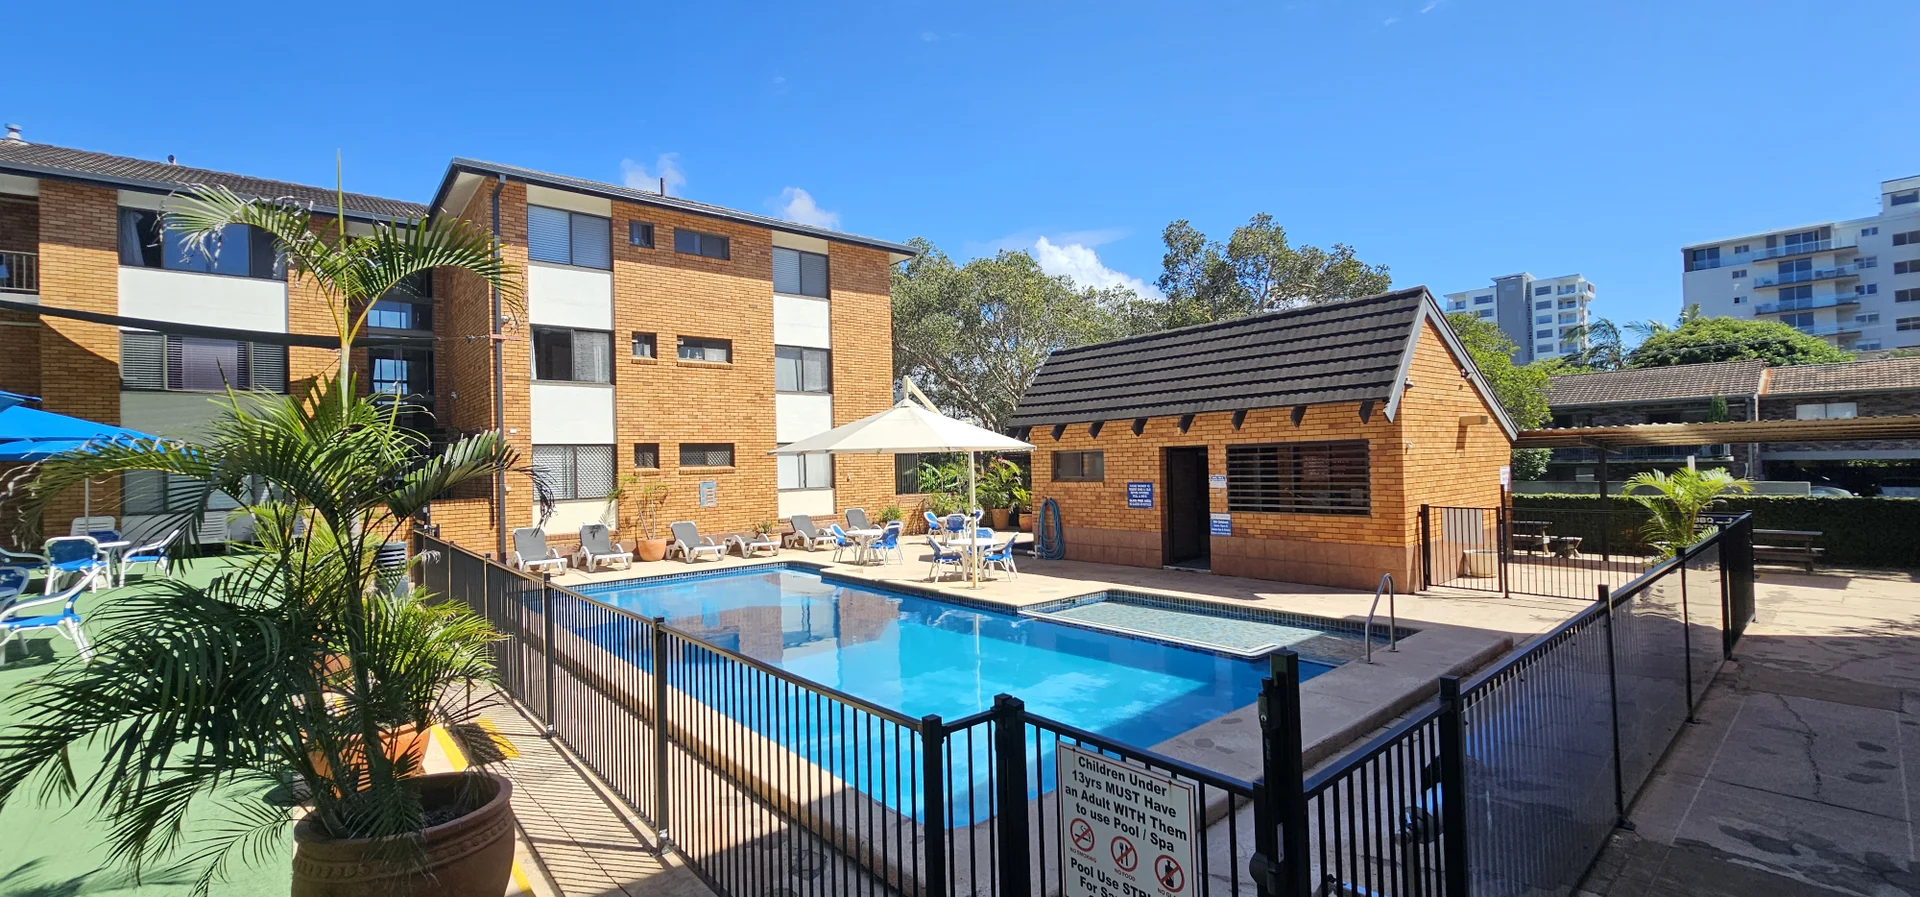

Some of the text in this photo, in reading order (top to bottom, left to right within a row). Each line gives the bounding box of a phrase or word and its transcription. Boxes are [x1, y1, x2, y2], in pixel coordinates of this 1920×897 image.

[1072, 770, 1177, 818] 13yrs MUST Have
[1078, 756, 1167, 796] Children Under
[1065, 785, 1188, 841] an Adult WITH Them
[1076, 802, 1087, 816] to
[1090, 810, 1110, 825] use
[1114, 817, 1139, 838] Pool
[1149, 832, 1175, 853] Spa
[1071, 856, 1093, 878] Pool
[1097, 869, 1119, 890] Use
[1077, 850, 1097, 863] SMOKING
[1114, 868, 1136, 882] NO FOOD
[1080, 875, 1097, 894] For
